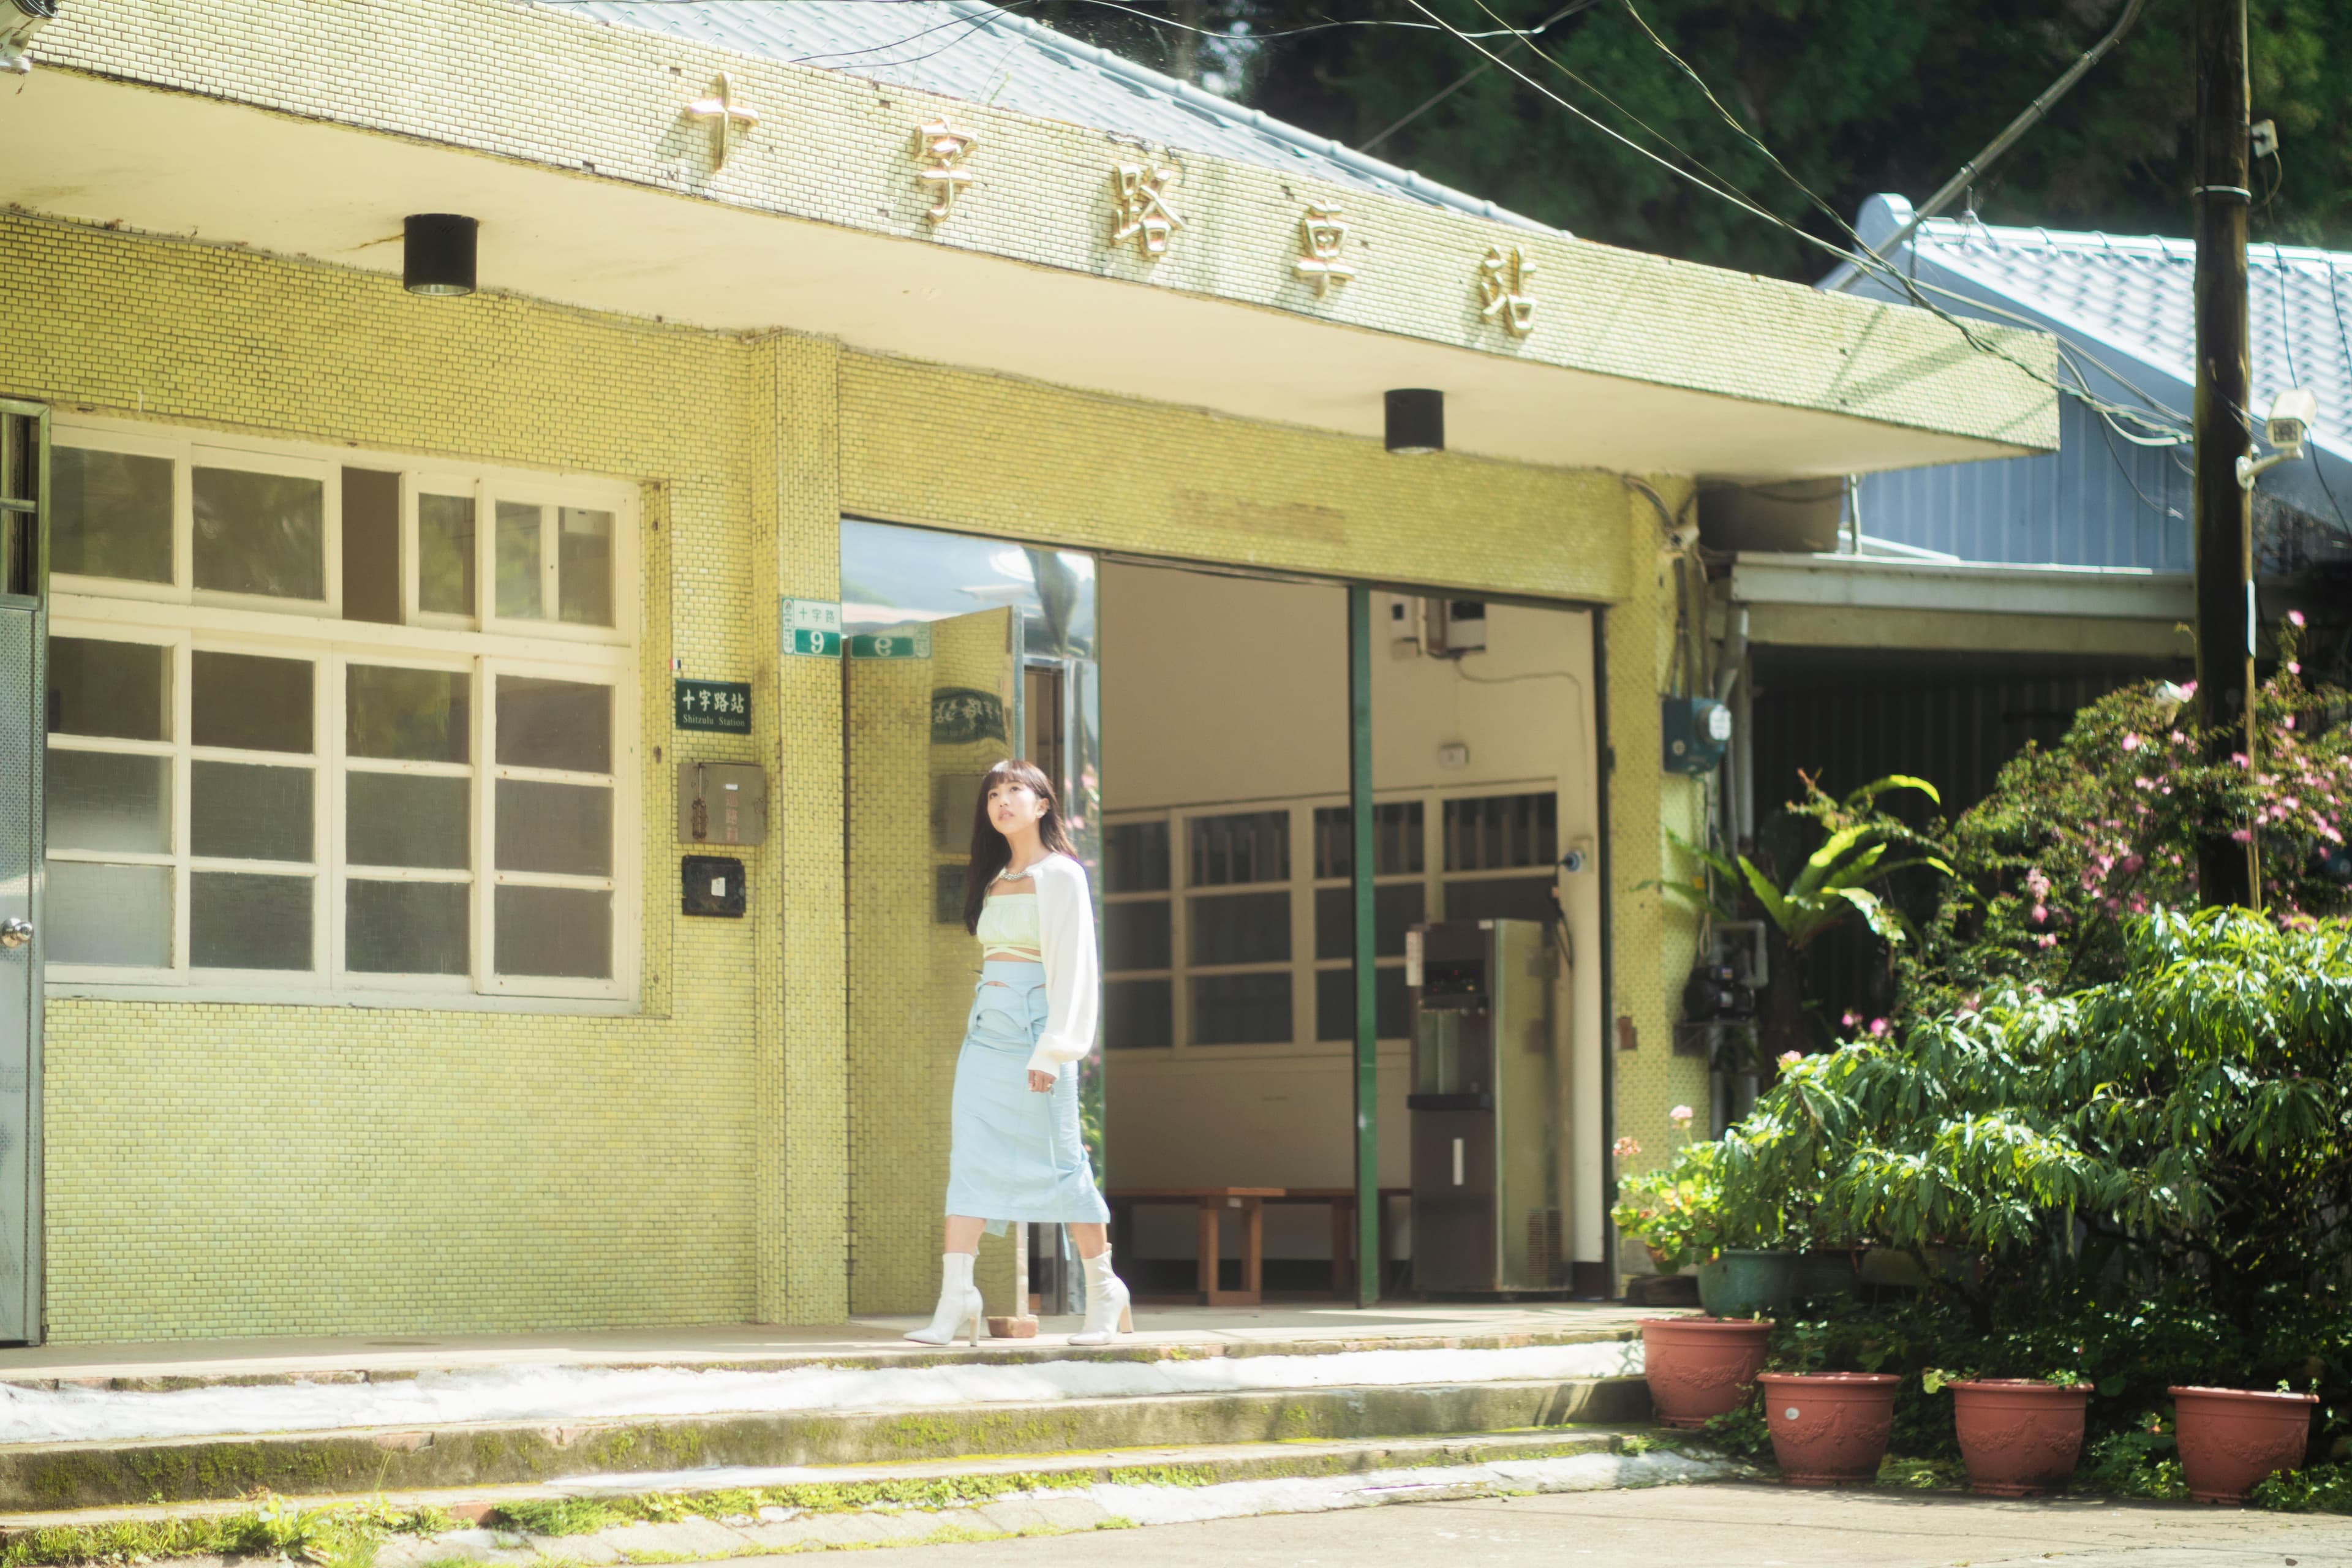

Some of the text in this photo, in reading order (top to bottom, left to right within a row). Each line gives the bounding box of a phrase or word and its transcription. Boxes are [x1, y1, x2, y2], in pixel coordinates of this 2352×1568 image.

[684, 70, 1537, 337] 十字路車站
[798, 606, 835, 624] 十字路
[810, 631, 824, 654] 9
[682, 688, 745, 714] 十字路站
[683, 714, 745, 727] Shitzulu Station
